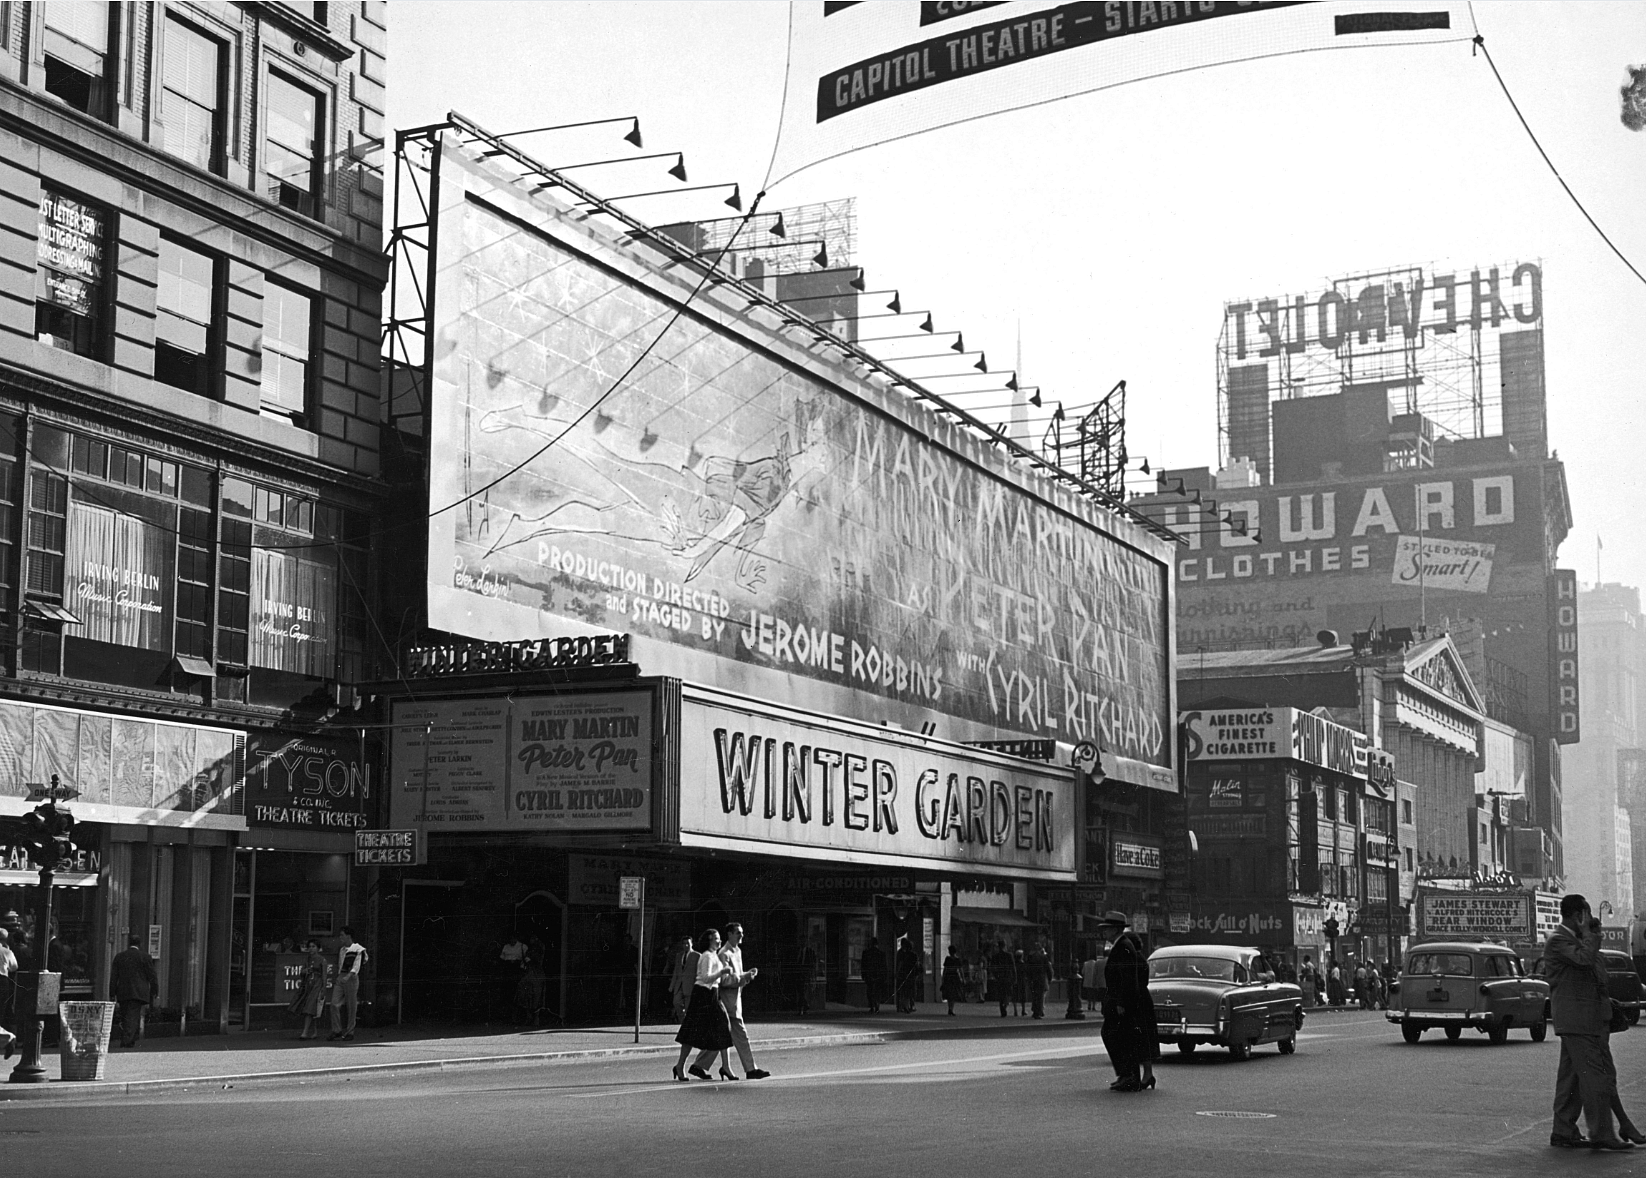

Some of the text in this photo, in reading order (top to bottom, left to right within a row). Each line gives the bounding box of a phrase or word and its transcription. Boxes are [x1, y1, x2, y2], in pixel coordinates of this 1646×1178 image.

[835, 48, 936, 108] CAPITOL
[946, 13, 1065, 73] THEATRE
[53, 202, 80, 230] LETTER
[1164, 475, 1514, 551] HOWARD
[1403, 542, 1451, 556] STYLED
[1454, 547, 1471, 557] TO
[84, 560, 159, 591] IRVING BERLIN
[1179, 545, 1370, 582] CLOTHES
[1400, 553, 1479, 584] Smart!
[538, 541, 730, 619] PRODUCTION DIRECTED
[77, 582, 162, 614] Music Corporation
[1176, 596, 1315, 619] lothing and
[264, 599, 326, 624] IRVING BERLIN
[606, 592, 725, 642] and STAGED BY
[259, 620, 328, 645] Music Corporation
[1176, 621, 1315, 644] urnishings
[517, 633, 629, 668] GARDEN
[741, 609, 943, 700] JEROME ROBBINS
[1558, 579, 1577, 733] HOWARD
[957, 648, 1163, 758] WITH CYRIL RITCHARD
[522, 716, 640, 741] MARY MARTIN
[1209, 712, 1274, 727] AMERICA'S
[1219, 727, 1265, 741] FINEST
[293, 744, 331, 755] ORIGINAL
[448, 755, 472, 763] LARKIN
[518, 740, 638, 775] Peter Pan
[1206, 741, 1276, 755] CIGARETTE
[256, 750, 370, 798] TYSON
[515, 788, 644, 811] CYRIL RITCHARD
[713, 728, 1053, 852] WINTER GARDEN
[255, 805, 367, 828] THEATRE TICKETS
[449, 814, 485, 822] ROBBINS
[357, 833, 412, 847] THEATRE
[357, 849, 411, 863] TICKETS
[1116, 843, 1134, 864] Have
[1140, 847, 1160, 868] Coke
[1432, 900, 1520, 909] JAMES STEWART
[1189, 914, 1211, 930] ock
[1211, 913, 1236, 934] full
[1249, 913, 1283, 935] Nuts
